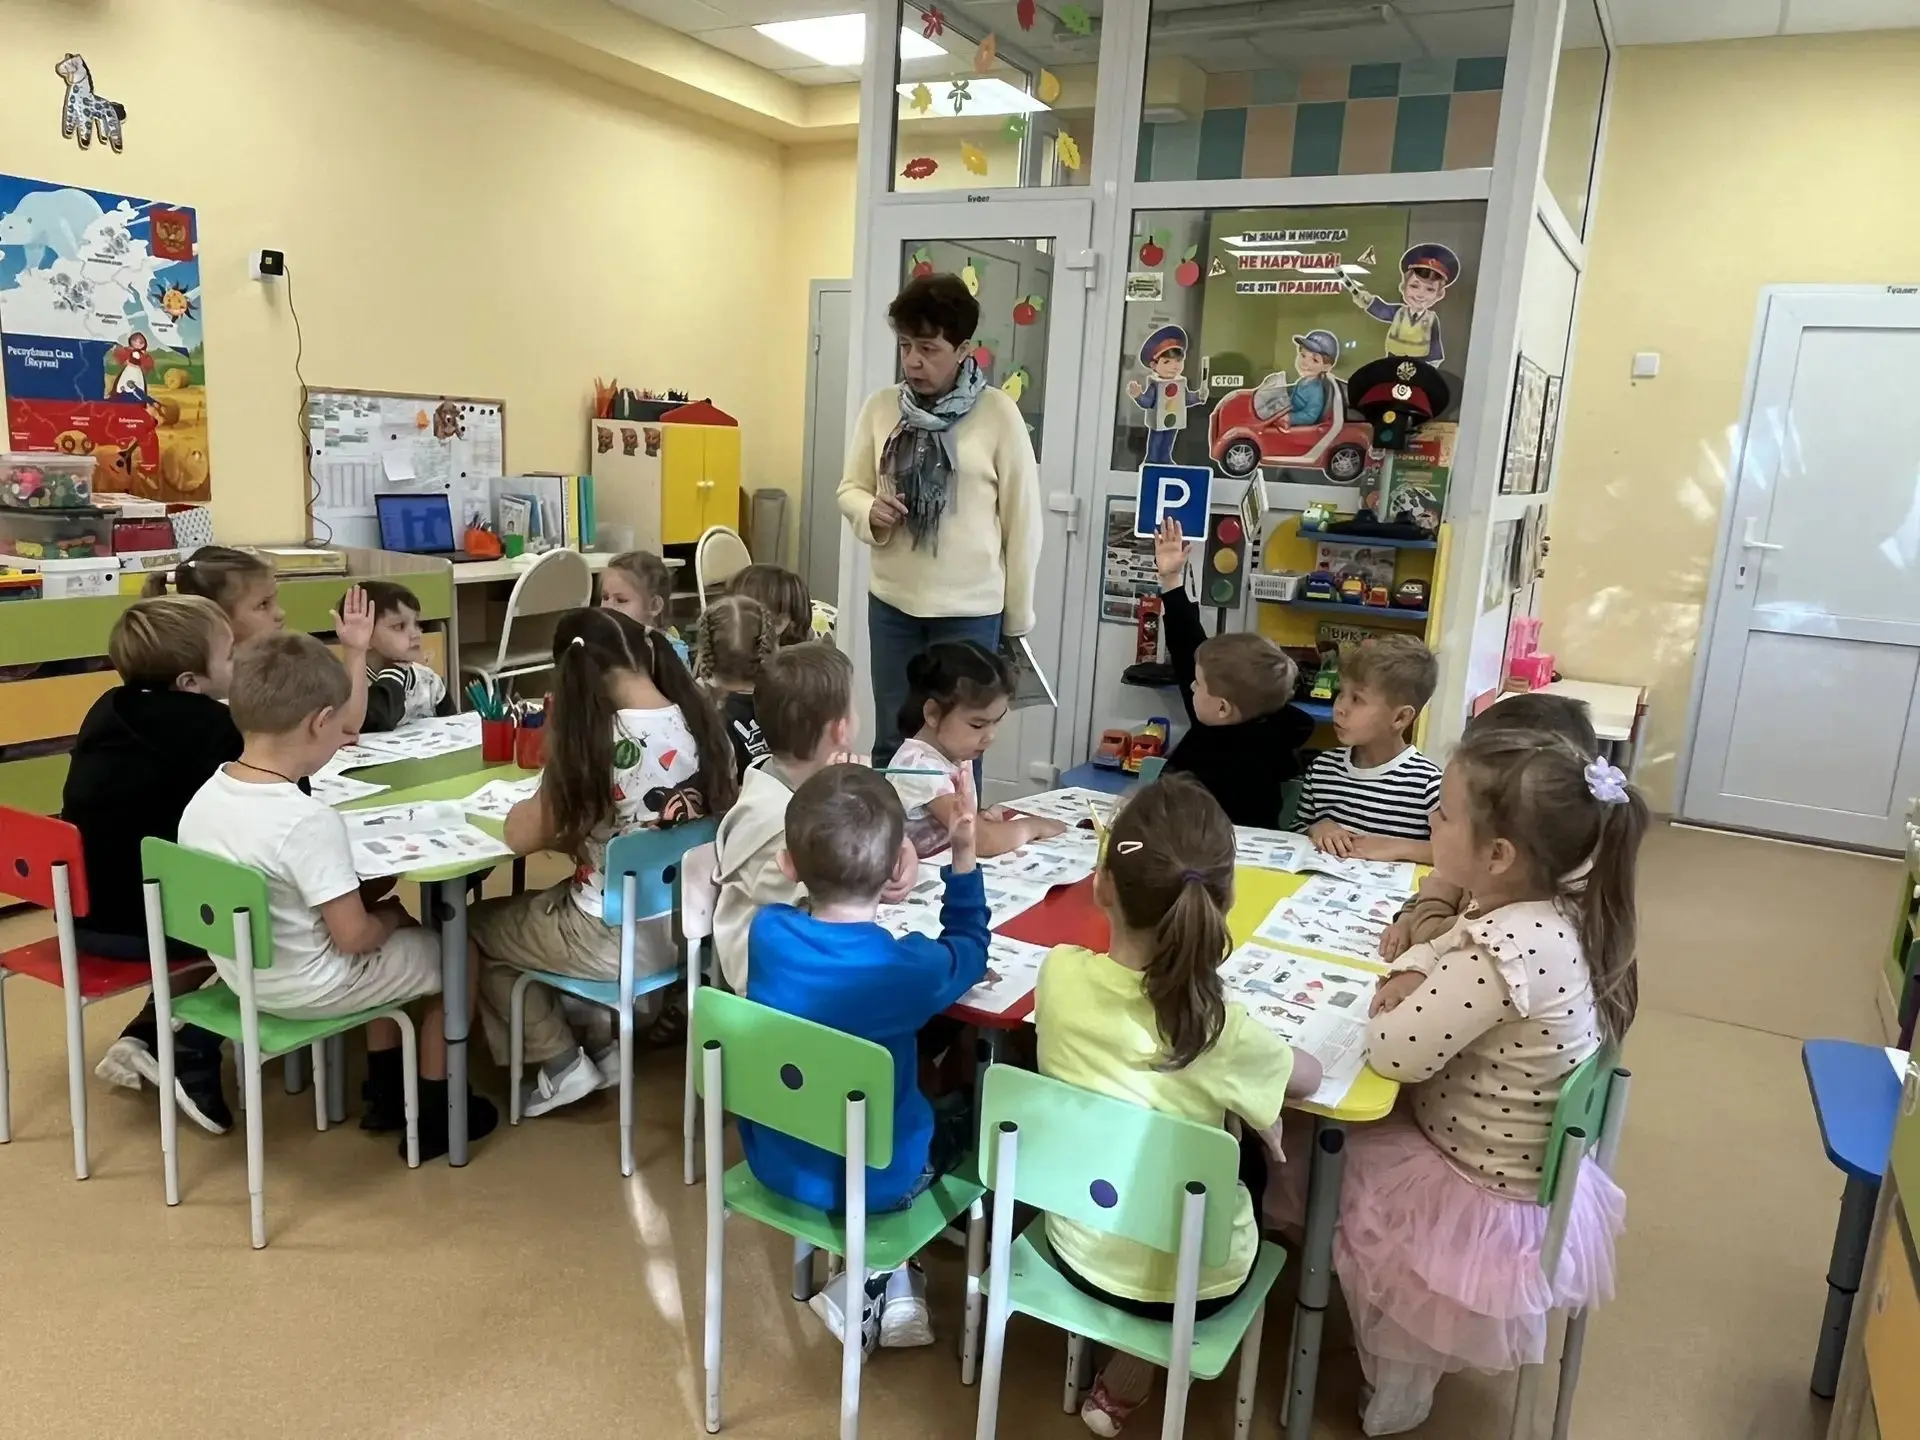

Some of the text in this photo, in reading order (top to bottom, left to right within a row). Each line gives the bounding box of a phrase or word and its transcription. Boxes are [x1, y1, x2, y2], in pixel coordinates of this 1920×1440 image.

[1242, 230, 1347, 243] ТЫ ЗНАЙ И НИКОГДА
[1239, 252, 1340, 269] НЕ НАРУШАЙ!
[1236, 282, 1341, 293] ВСЕ ЭТИ ПРАВИЛА
[7, 345, 74, 360] Республика Саха
[1215, 376, 1240, 386] СТОП
[1155, 476, 1191, 525] P
